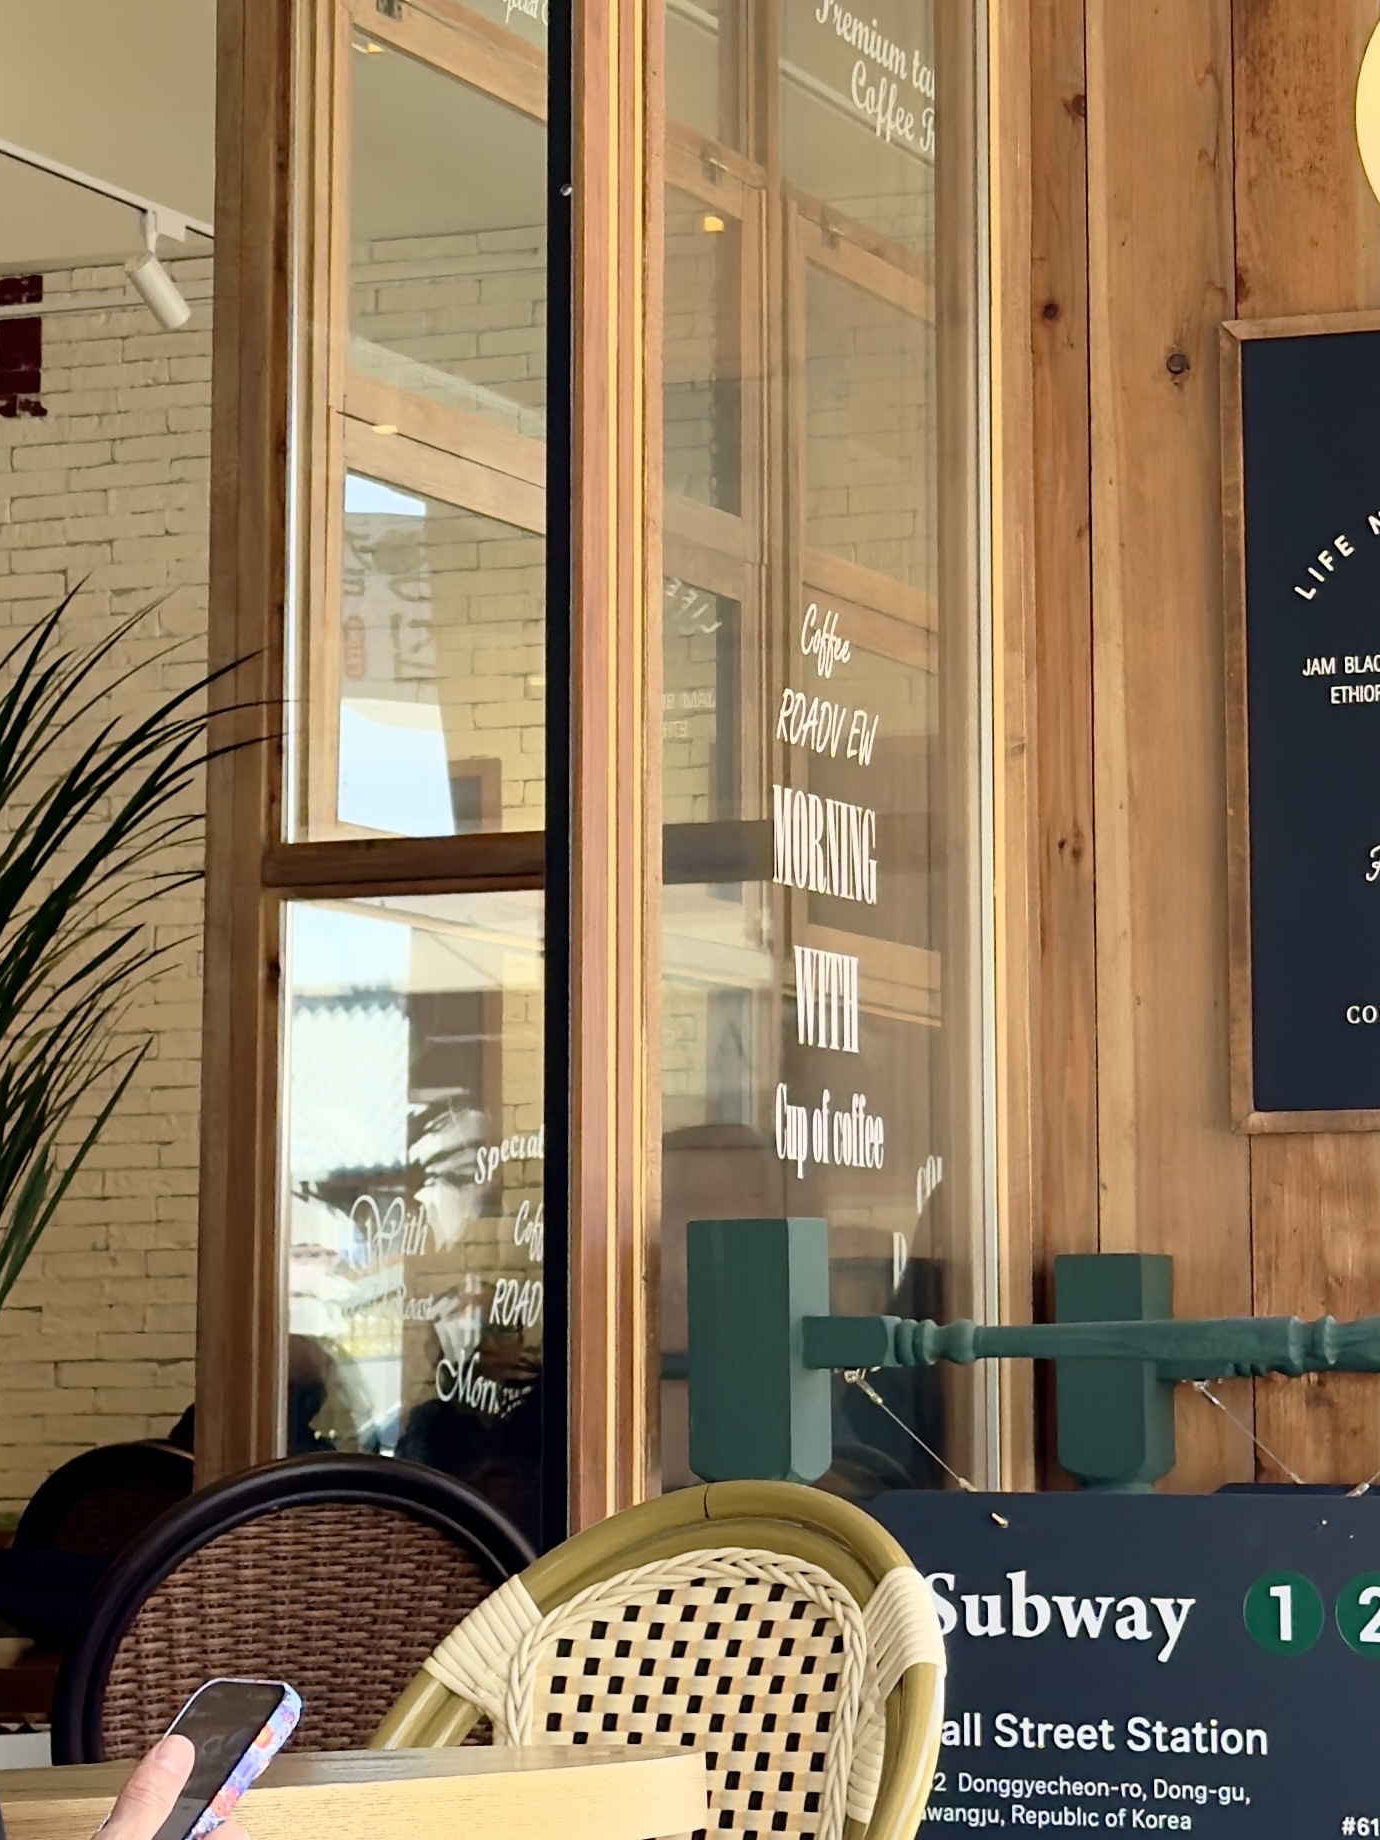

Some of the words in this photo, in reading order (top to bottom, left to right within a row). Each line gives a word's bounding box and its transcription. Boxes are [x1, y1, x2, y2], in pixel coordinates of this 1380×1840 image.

[852, 60, 914, 143] Coffee
[1294, 534, 1355, 601] LIFE
[801, 603, 851, 679] Coffee
[1302, 656, 1336, 677] JAM
[772, 785, 878, 905] MORNING
[794, 945, 860, 1053] WITH
[475, 1125, 544, 1185] Special
[775, 1082, 808, 1179] Cup
[812, 1089, 831, 1164] of
[833, 1093, 884, 1169] coffee
[513, 1200, 544, 1261] Coff
[489, 1278, 544, 1327] ROAD
[923, 1570, 1196, 1663] Subway
[1269, 1585, 1293, 1642] 1
[941, 1711, 981, 1746] all
[994, 1713, 1116, 1752] Street
[1126, 1716, 1268, 1756] Station
[929, 1773, 947, 1792] 2
[958, 1773, 1148, 1802] Donggyecheon-ro,
[1153, 1779, 1251, 1806] Dong-gu,
[1011, 1805, 1099, 1829] Republic
[1104, 1807, 1126, 1828] of
[1132, 1809, 1192, 1830] Korea
